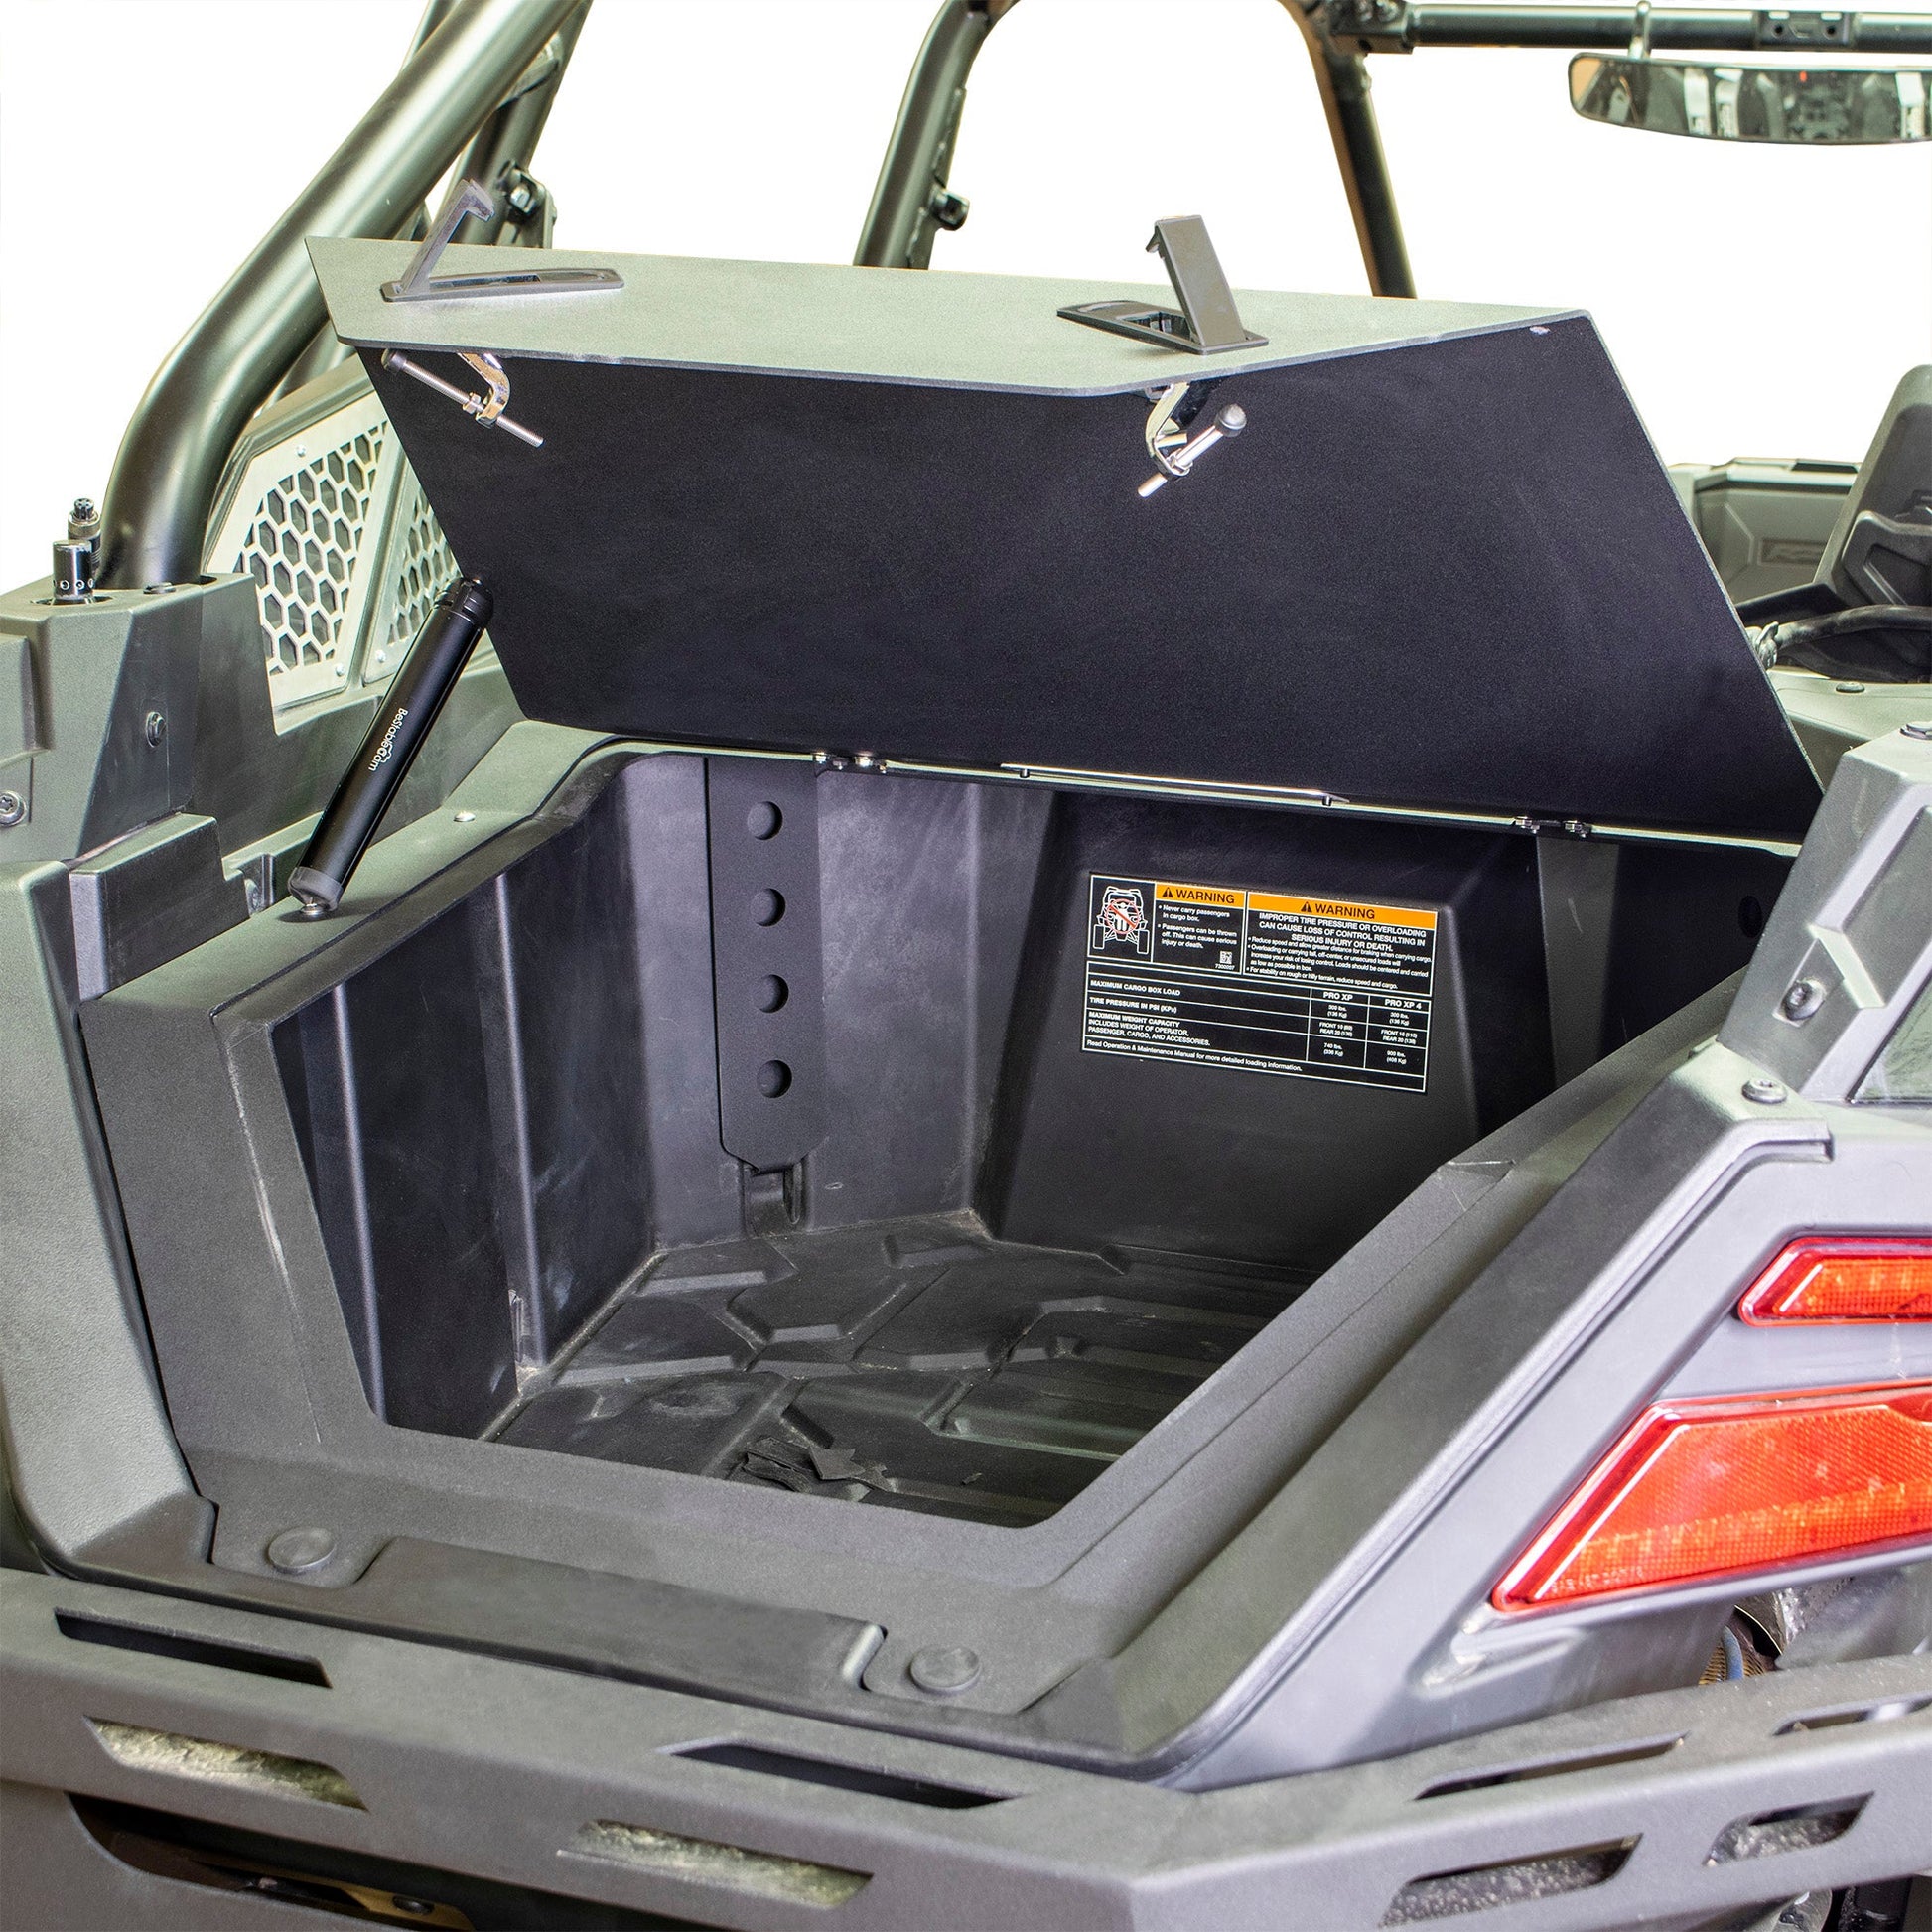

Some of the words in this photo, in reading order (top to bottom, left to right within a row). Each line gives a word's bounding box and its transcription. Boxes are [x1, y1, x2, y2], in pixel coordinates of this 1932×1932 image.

[1176, 889, 1234, 903] WARNING
[1315, 903, 1375, 919] WARNING
[1162, 923, 1195, 932] Passengers
[1259, 913, 1299, 923] IMPROPER
[1317, 919, 1357, 930] PRESSURE
[1372, 925, 1426, 937] OVERLOADING
[1277, 923, 1303, 932] CAUSE
[1336, 930, 1372, 940] CONTROL
[1374, 934, 1416, 945] RESULTING
[1292, 934, 1324, 943] SERIOUS
[1325, 938, 1352, 947] INJURY
[1252, 944, 1281, 953] Overloading
[1395, 953, 1416, 962] carrying
[1090, 980, 1122, 989] MAXIMUM
[1106, 999, 1139, 1008] PRESSURE
[1089, 1012, 1121, 1021] MAXIMUM
[1122, 1015, 1148, 1024] WEIGHT
[1148, 1018, 1180, 1028] CAPACITY
[1088, 1027, 1126, 1036] PASSENGER,
[1127, 1031, 1151, 1039] CARGO,
[1166, 1035, 1210, 1045] ACCESSORIES.
[1155, 1026, 1189, 1036] OPERATOR,
[1103, 1041, 1131, 1050] Operation
[1137, 1045, 1173, 1056] Maintenance
[1246, 1059, 1267, 1068] loading
[1268, 1062, 1302, 1071] information.
